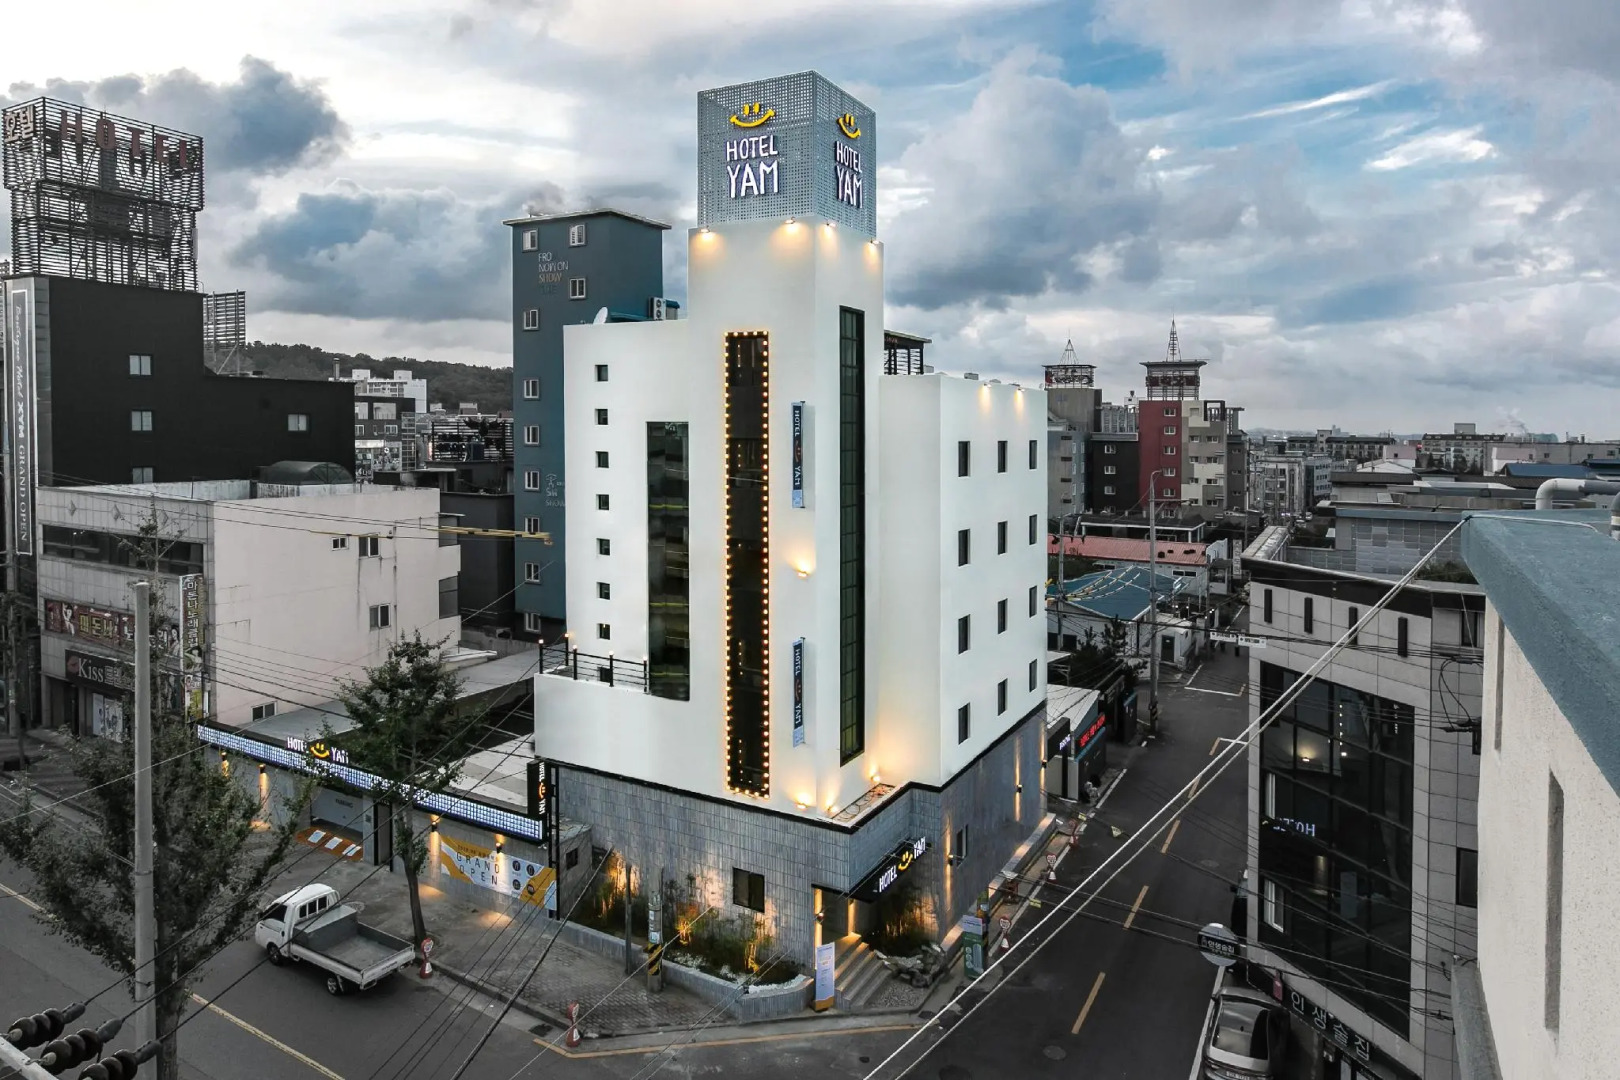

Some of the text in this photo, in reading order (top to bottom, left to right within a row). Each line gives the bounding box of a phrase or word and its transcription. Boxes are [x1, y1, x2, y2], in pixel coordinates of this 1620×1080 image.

[5, 104, 35, 142] 호텔
[60, 109, 195, 169] HOTEL
[726, 134, 779, 162] HOTEL
[836, 140, 863, 173] HOTEL
[726, 159, 780, 199] YAM
[836, 165, 863, 209] YAM
[15, 365, 24, 398] Hotel
[20, 501, 28, 541] OPEN
[77, 657, 104, 683] Kiss
[287, 736, 309, 754] HOTE
[538, 761, 546, 815] HOTEL YAM
[456, 851, 501, 875] GRAND
[459, 864, 498, 886] OPEN
[879, 836, 926, 893] HOTEL YAM
[1290, 990, 1371, 1062] 인생술집
